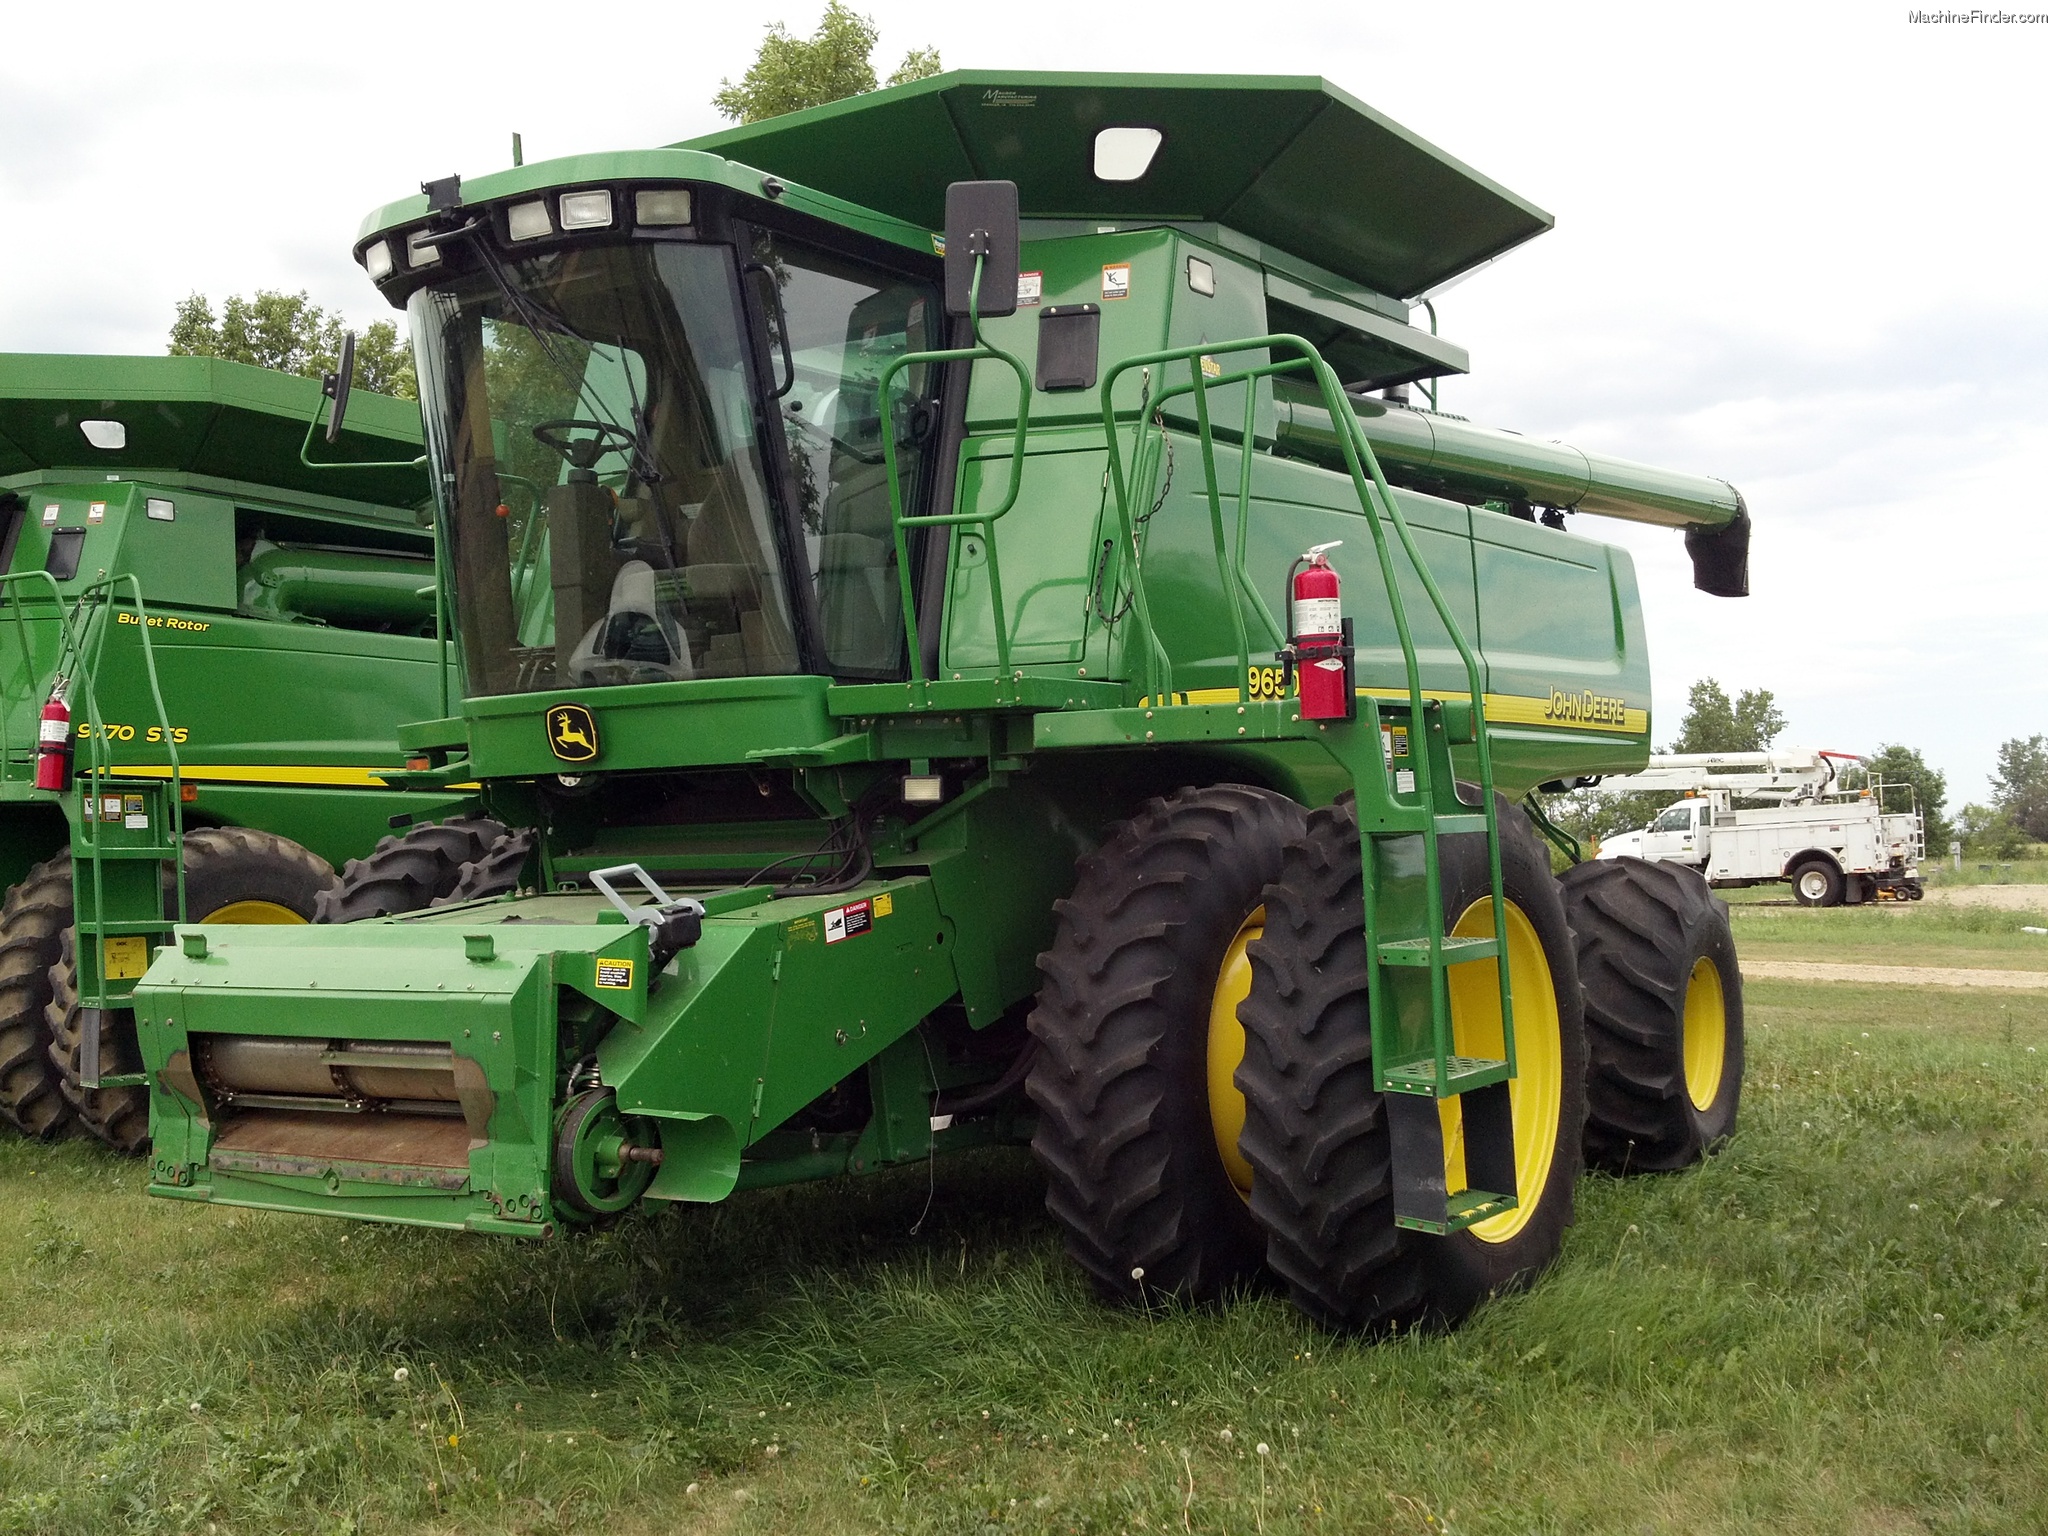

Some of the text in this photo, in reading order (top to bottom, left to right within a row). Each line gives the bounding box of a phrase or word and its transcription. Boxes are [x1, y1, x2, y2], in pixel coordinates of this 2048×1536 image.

[117, 612, 210, 632] Buet Rotor
[1544, 684, 1625, 725] JOHN DEERE
[77, 723, 135, 742] 970
